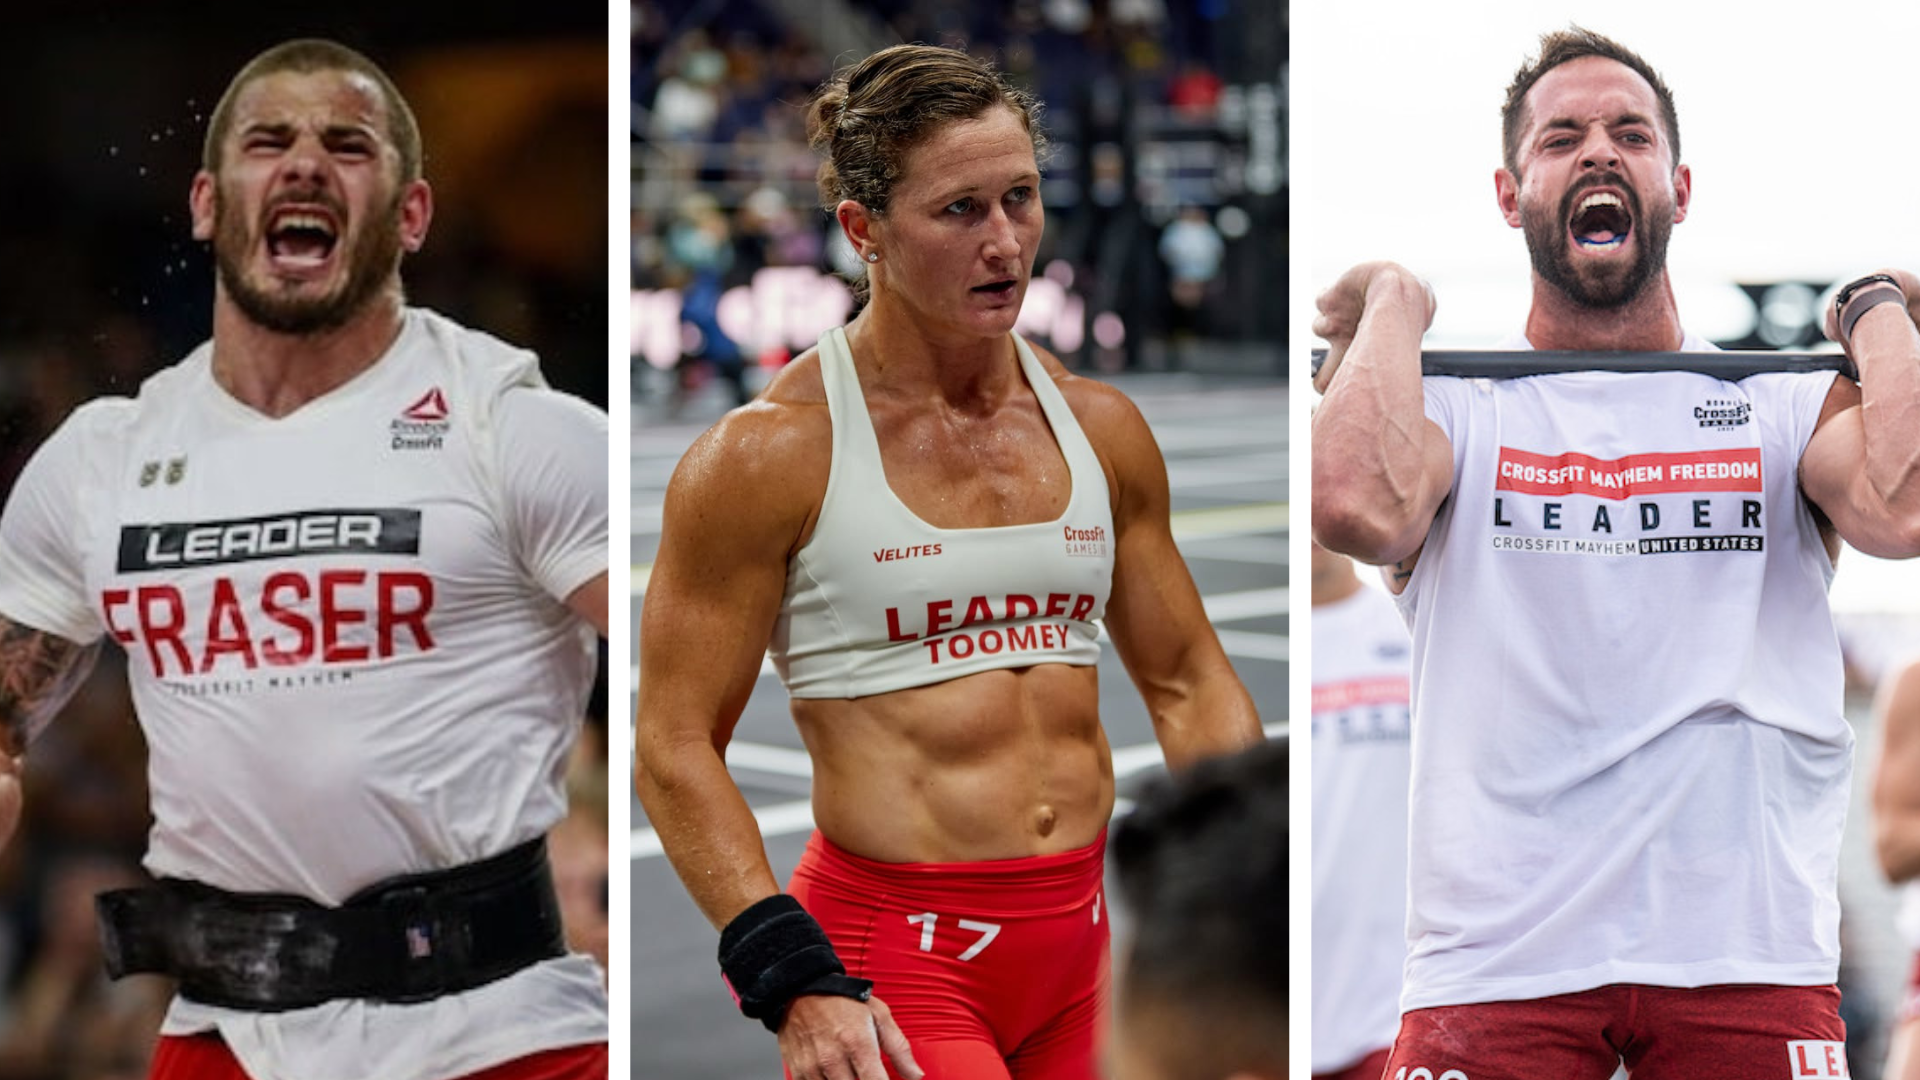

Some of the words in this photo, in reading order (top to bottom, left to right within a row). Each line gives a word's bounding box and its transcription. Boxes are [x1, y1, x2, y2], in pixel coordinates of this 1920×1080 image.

[1694, 403, 1752, 419] CrossFit
[1501, 461, 1585, 484] CROSSFIT
[1590, 465, 1663, 489] MAYHEM
[1670, 461, 1758, 480] FREEDOM
[1494, 498, 1762, 533] LEADER
[146, 515, 383, 564] LEADER
[1064, 525, 1105, 541] CrossFit
[1493, 537, 1569, 551] CROSSFIT
[1576, 541, 1636, 555] MAYHEM
[1641, 539, 1698, 554] UNITED
[1702, 537, 1760, 551] STATES
[873, 543, 942, 563] VELITES
[1065, 543, 1098, 555] GAMES
[102, 570, 436, 678] FRASER
[885, 593, 1095, 642] LEADER
[923, 624, 1069, 664] TOOMEY
[906, 912, 1001, 961] 17
[1796, 1045, 1848, 1077] LE
